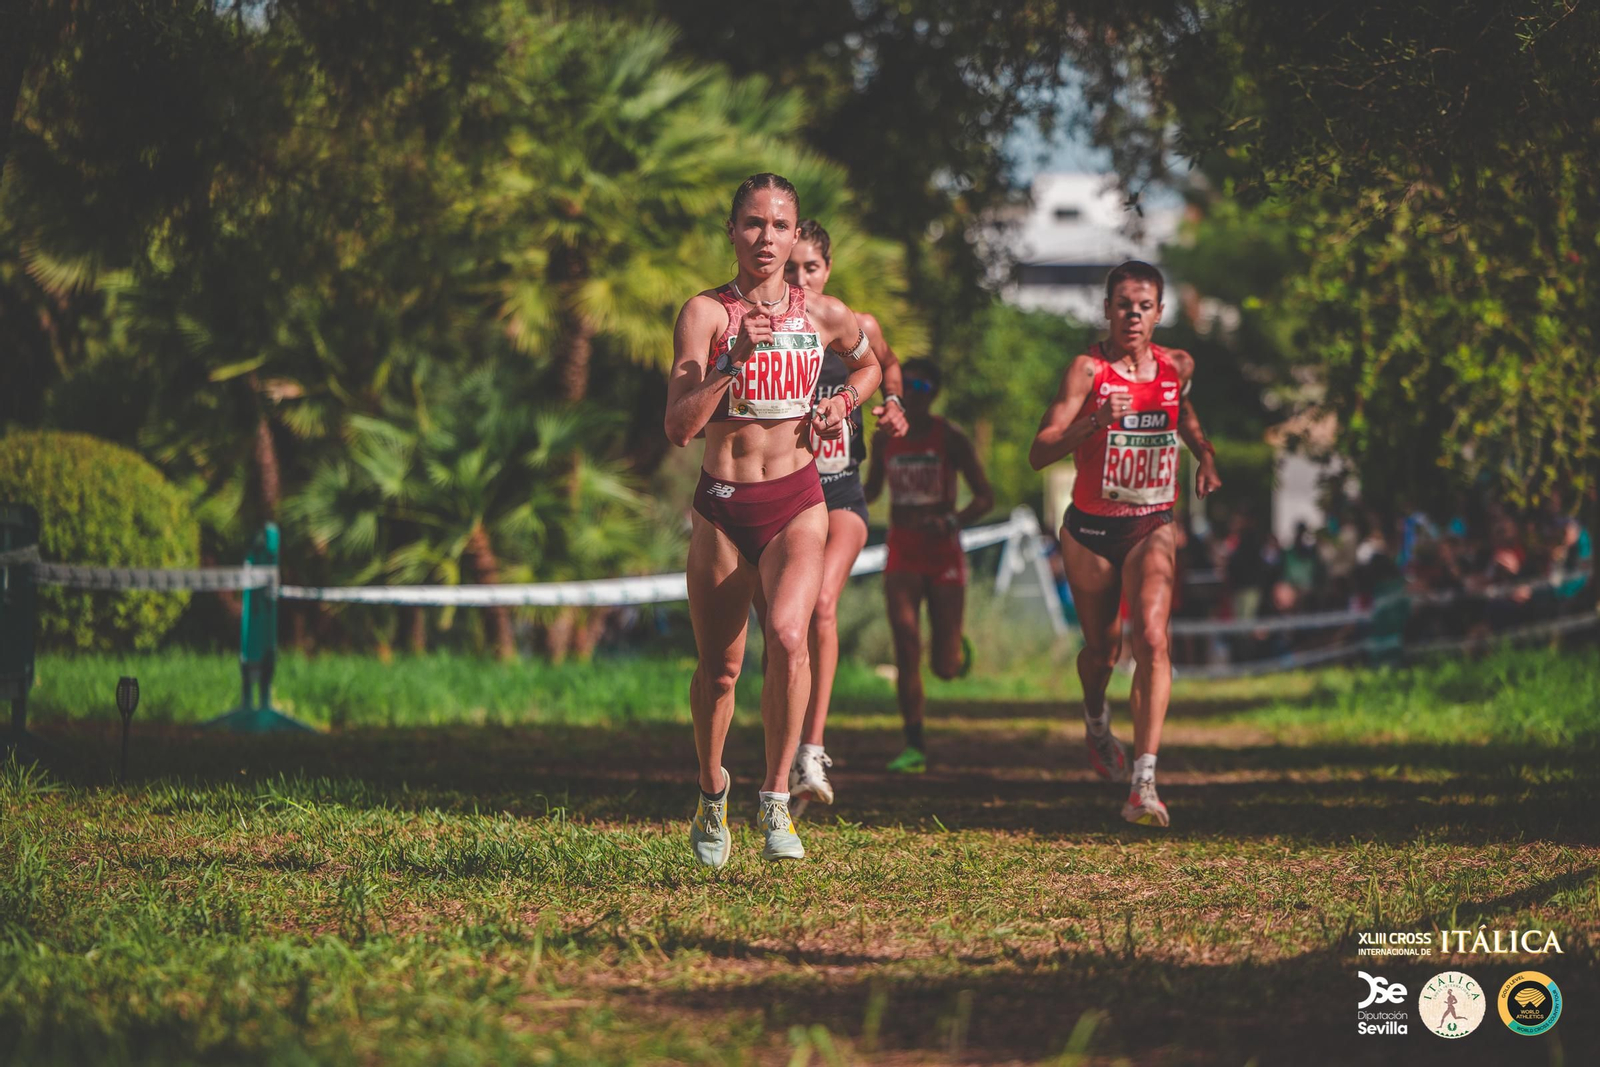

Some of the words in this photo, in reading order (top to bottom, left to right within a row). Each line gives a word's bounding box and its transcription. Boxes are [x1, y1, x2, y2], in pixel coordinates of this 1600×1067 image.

[732, 349, 820, 400] SERRANO
[1140, 414, 1166, 428] BM
[1106, 447, 1175, 489] ROBLES
